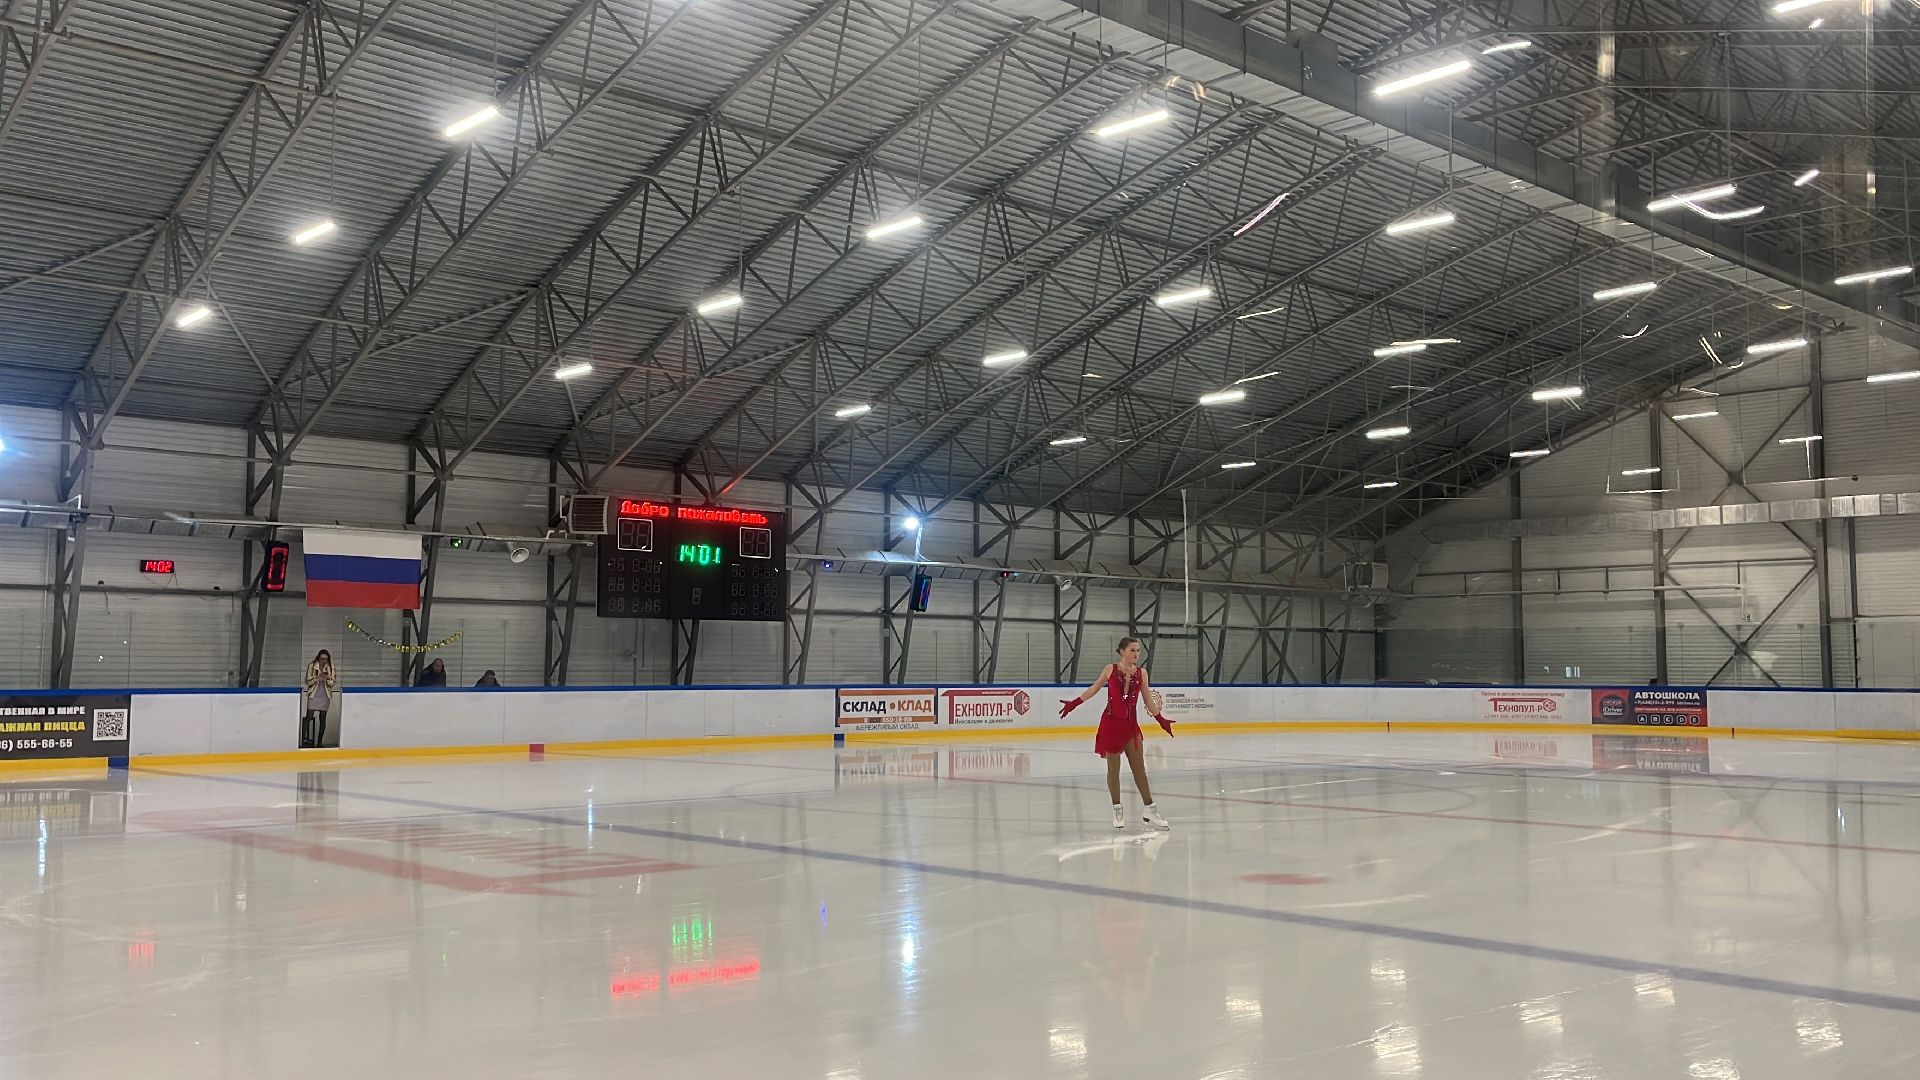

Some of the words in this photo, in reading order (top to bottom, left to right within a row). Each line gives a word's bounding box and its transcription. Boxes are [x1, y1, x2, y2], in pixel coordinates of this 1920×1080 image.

[621, 500, 669, 517] Добро
[1635, 691, 1700, 700] АВТОШКОЛА
[48, 707, 55, 715] В
[57, 706, 86, 715] МИРЕ
[843, 701, 887, 714] СКЛАД
[898, 700, 931, 712] КЛАД
[44, 722, 86, 732] ПИЦЦА
[0, 740, 13, 752] 6)
